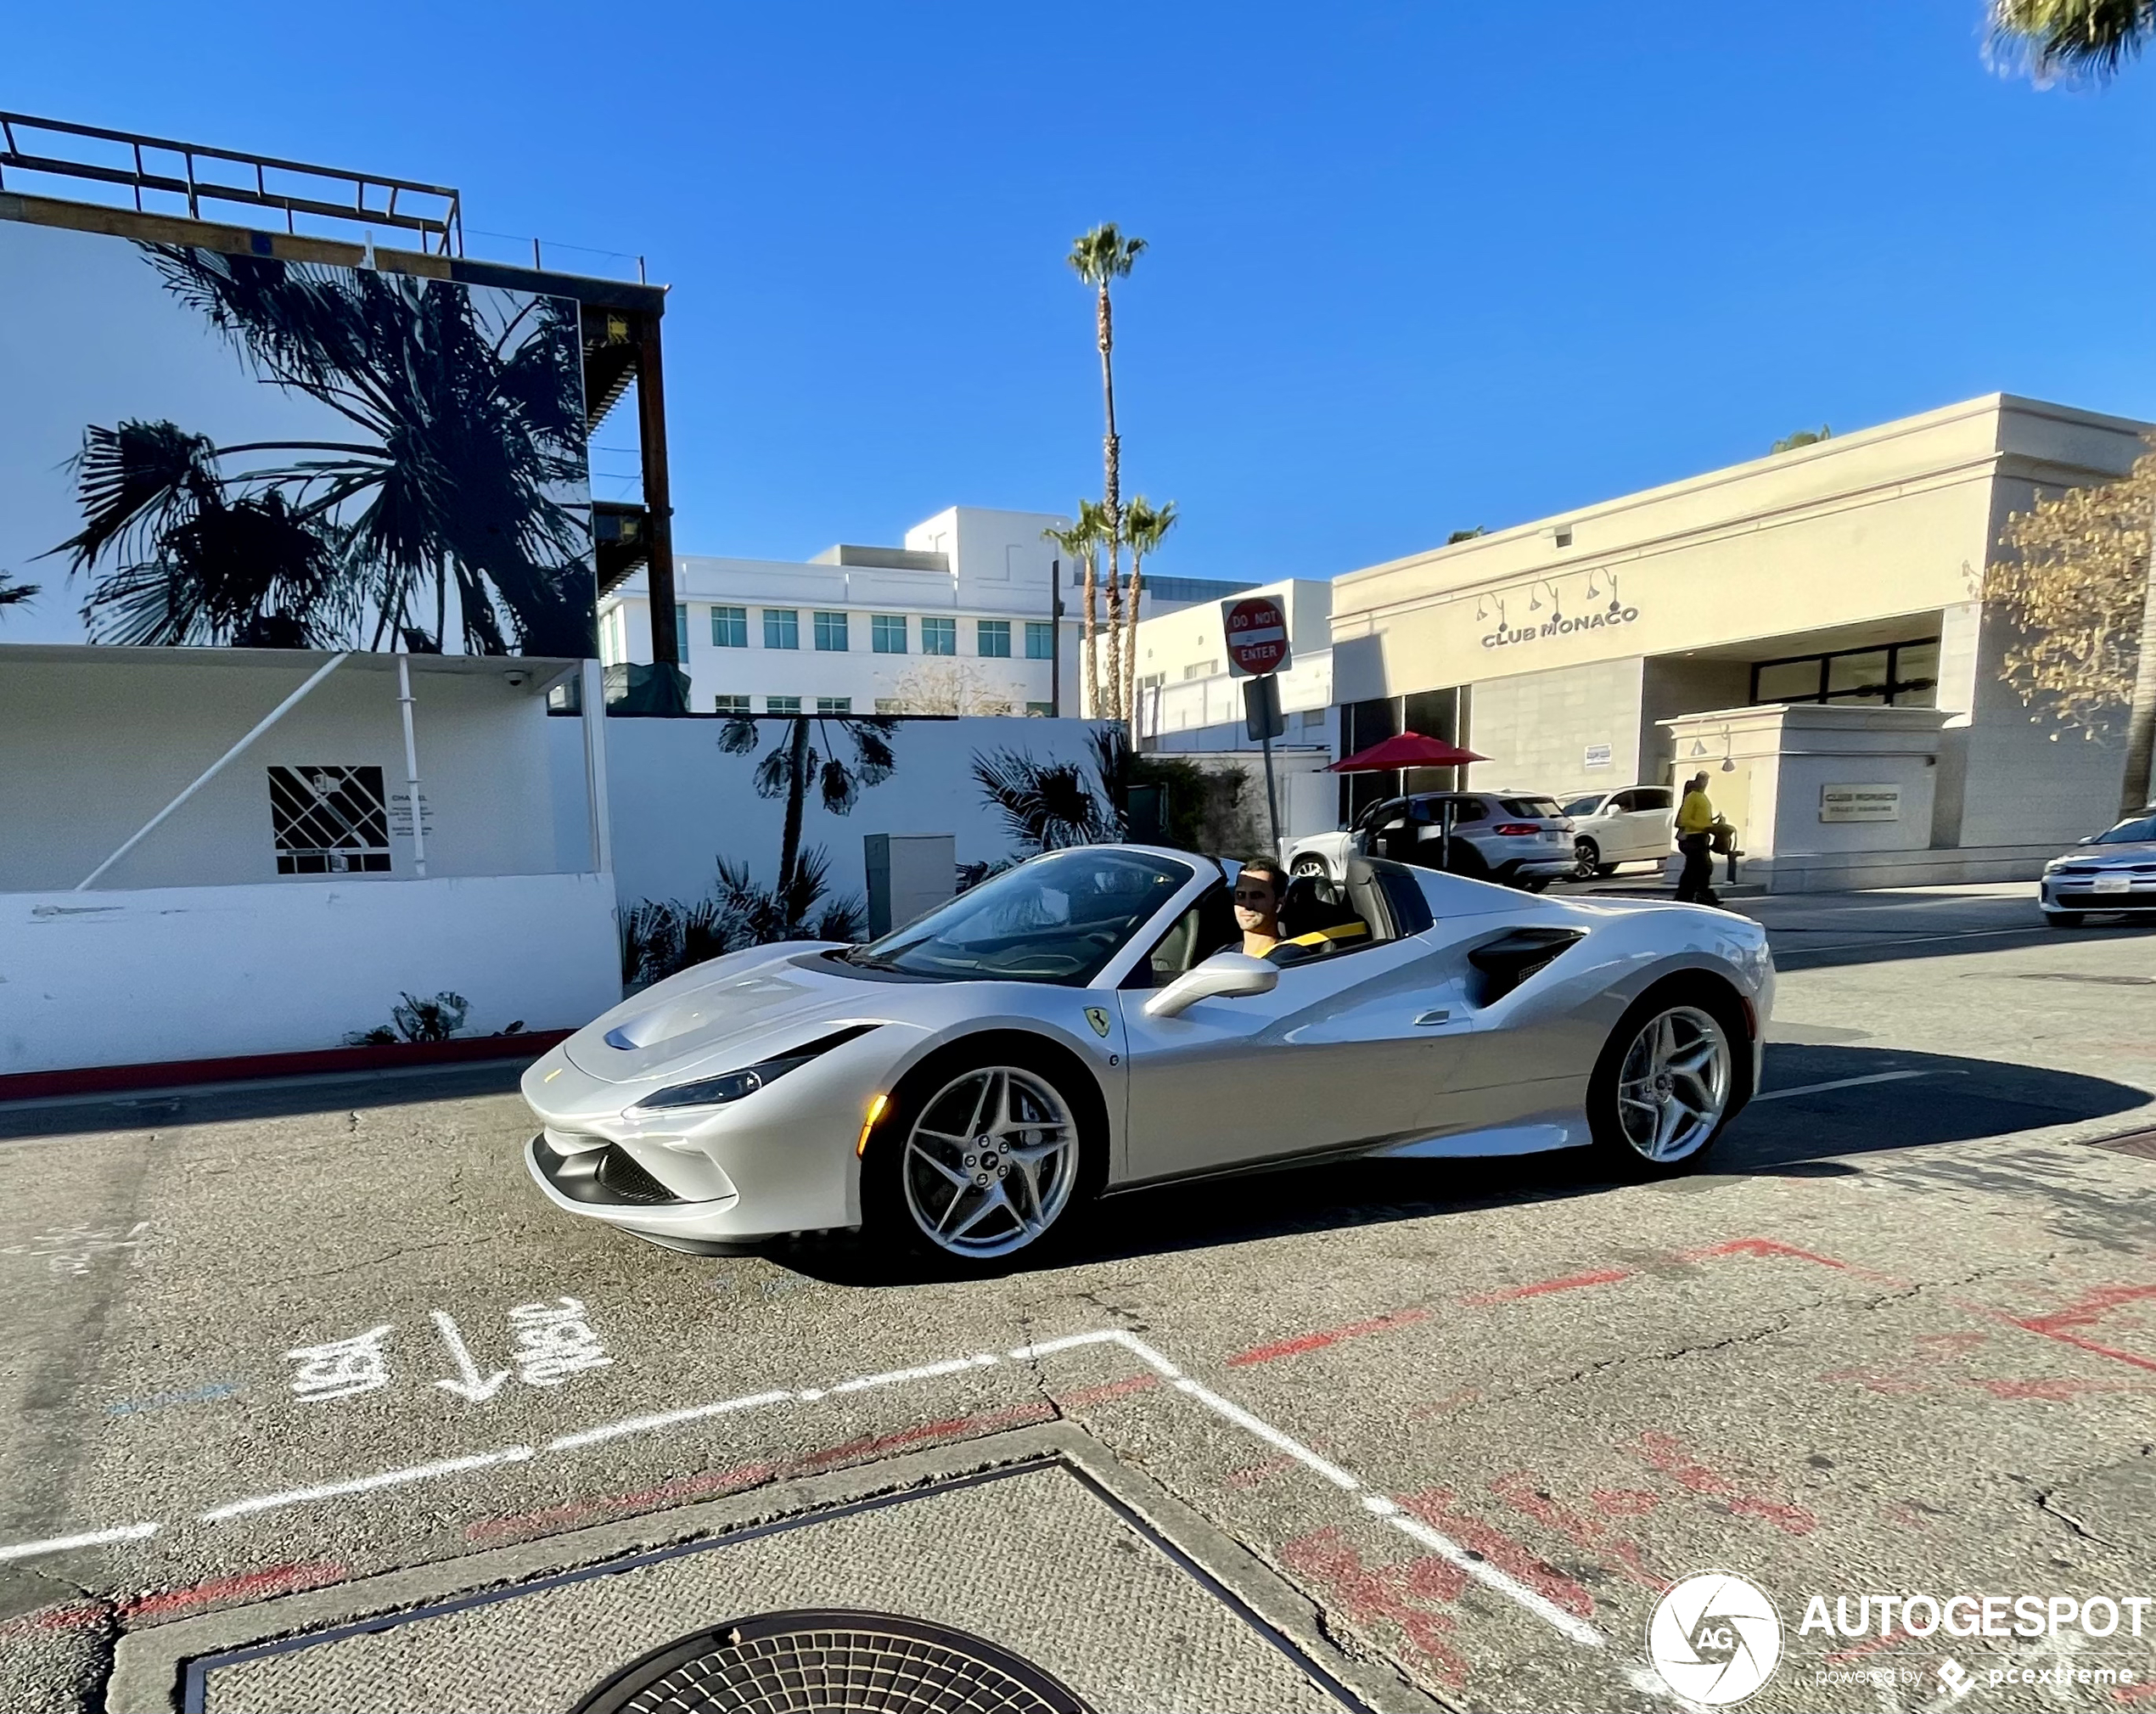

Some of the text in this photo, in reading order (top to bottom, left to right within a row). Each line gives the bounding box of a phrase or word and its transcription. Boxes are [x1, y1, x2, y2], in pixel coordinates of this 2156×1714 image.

[1232, 610, 1277, 627] DO NOT
[1481, 607, 1639, 648] CLUB MONACO
[1241, 645, 1277, 661] ENTER
